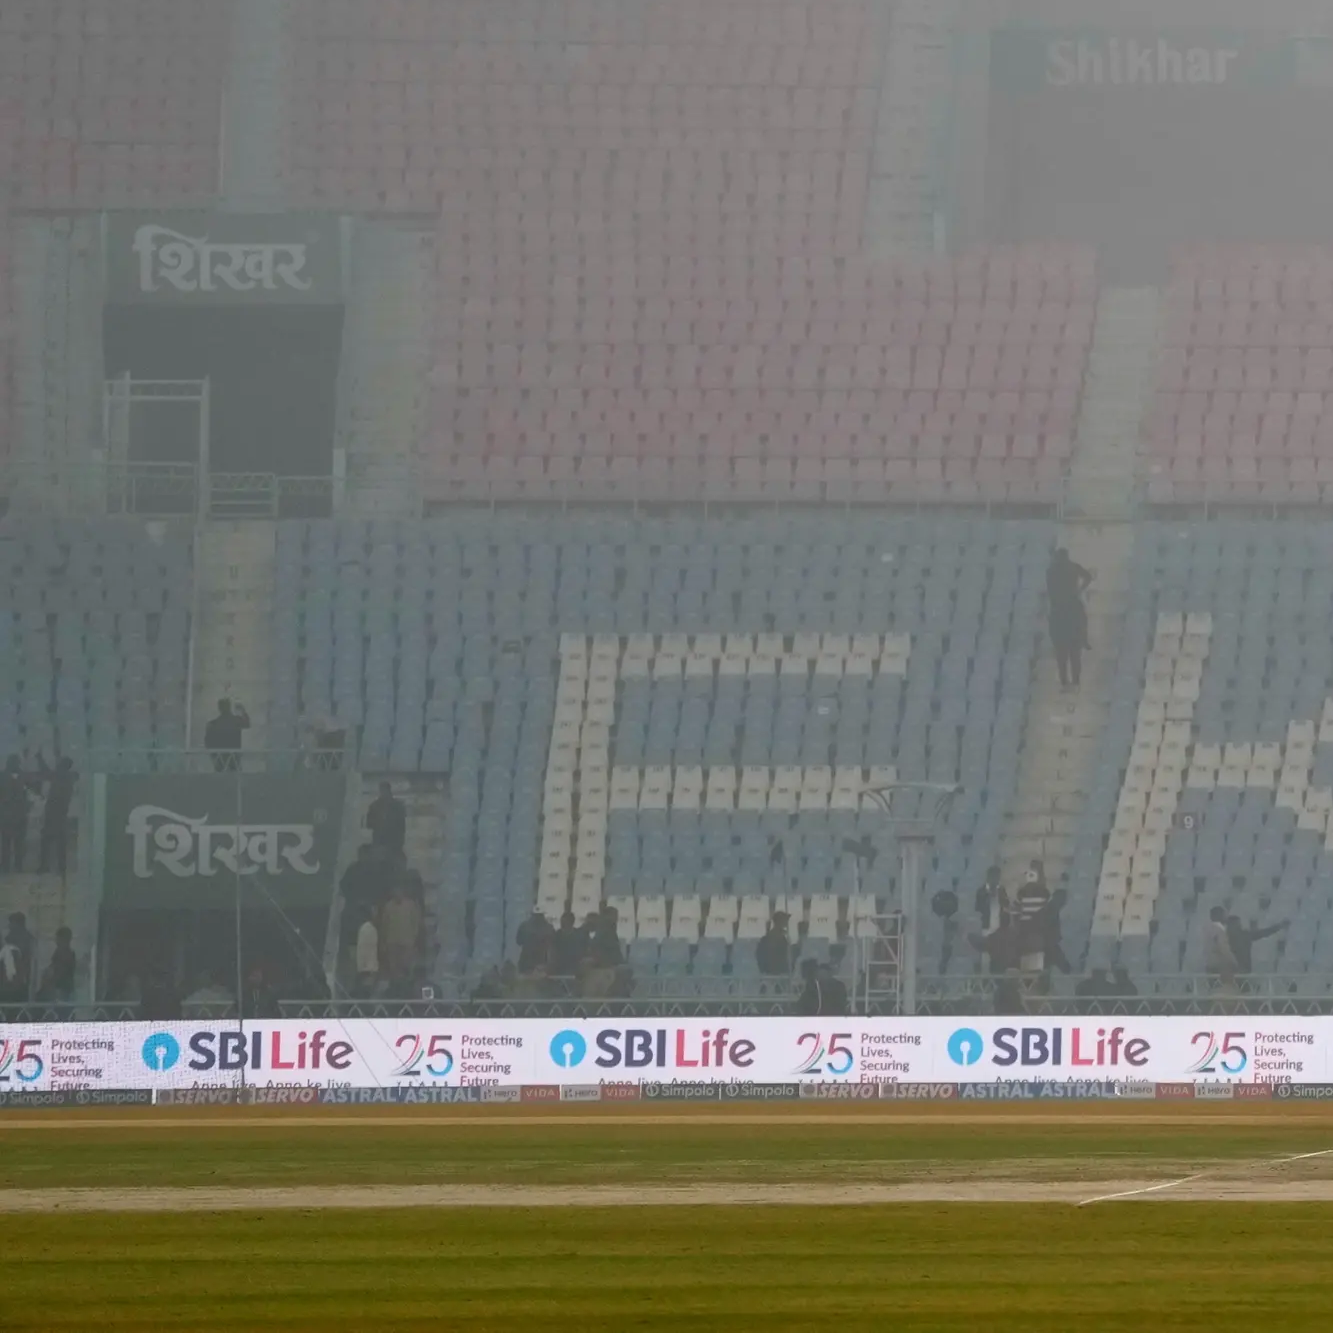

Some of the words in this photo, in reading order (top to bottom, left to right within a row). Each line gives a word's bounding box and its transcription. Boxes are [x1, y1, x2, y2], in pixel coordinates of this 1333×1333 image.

[1045, 36, 1239, 85] Shikhar
[133, 224, 313, 293] शिखर
[126, 804, 322, 879] शिखर
[51, 1038, 115, 1052] Protecting
[461, 1034, 523, 1048] Protecting
[861, 1032, 921, 1046] Protecting
[1254, 1031, 1314, 1045] Protecting
[187, 1028, 262, 1072] SBI
[270, 1029, 354, 1070] Life
[594, 1028, 667, 1069] SBI
[675, 1027, 756, 1068] Life
[796, 1032, 854, 1075] 25
[991, 1027, 1063, 1067] SBI
[1070, 1026, 1151, 1067] Life
[1190, 1031, 1248, 1074] 25
[395, 1034, 454, 1077] 25
[50, 1065, 103, 1079] Securing
[460, 1061, 511, 1076] Securing
[860, 1059, 910, 1073] Securing
[1254, 1058, 1303, 1072] Securing
[256, 1088, 314, 1104] SERVO
[404, 1087, 476, 1103] ASTRAL
[525, 1087, 555, 1097] VIDA
[660, 1083, 716, 1098] Simpolo
[741, 1083, 796, 1098] Simpolo
[818, 1084, 875, 1099] SERVO
[896, 1084, 953, 1099] SERVO
